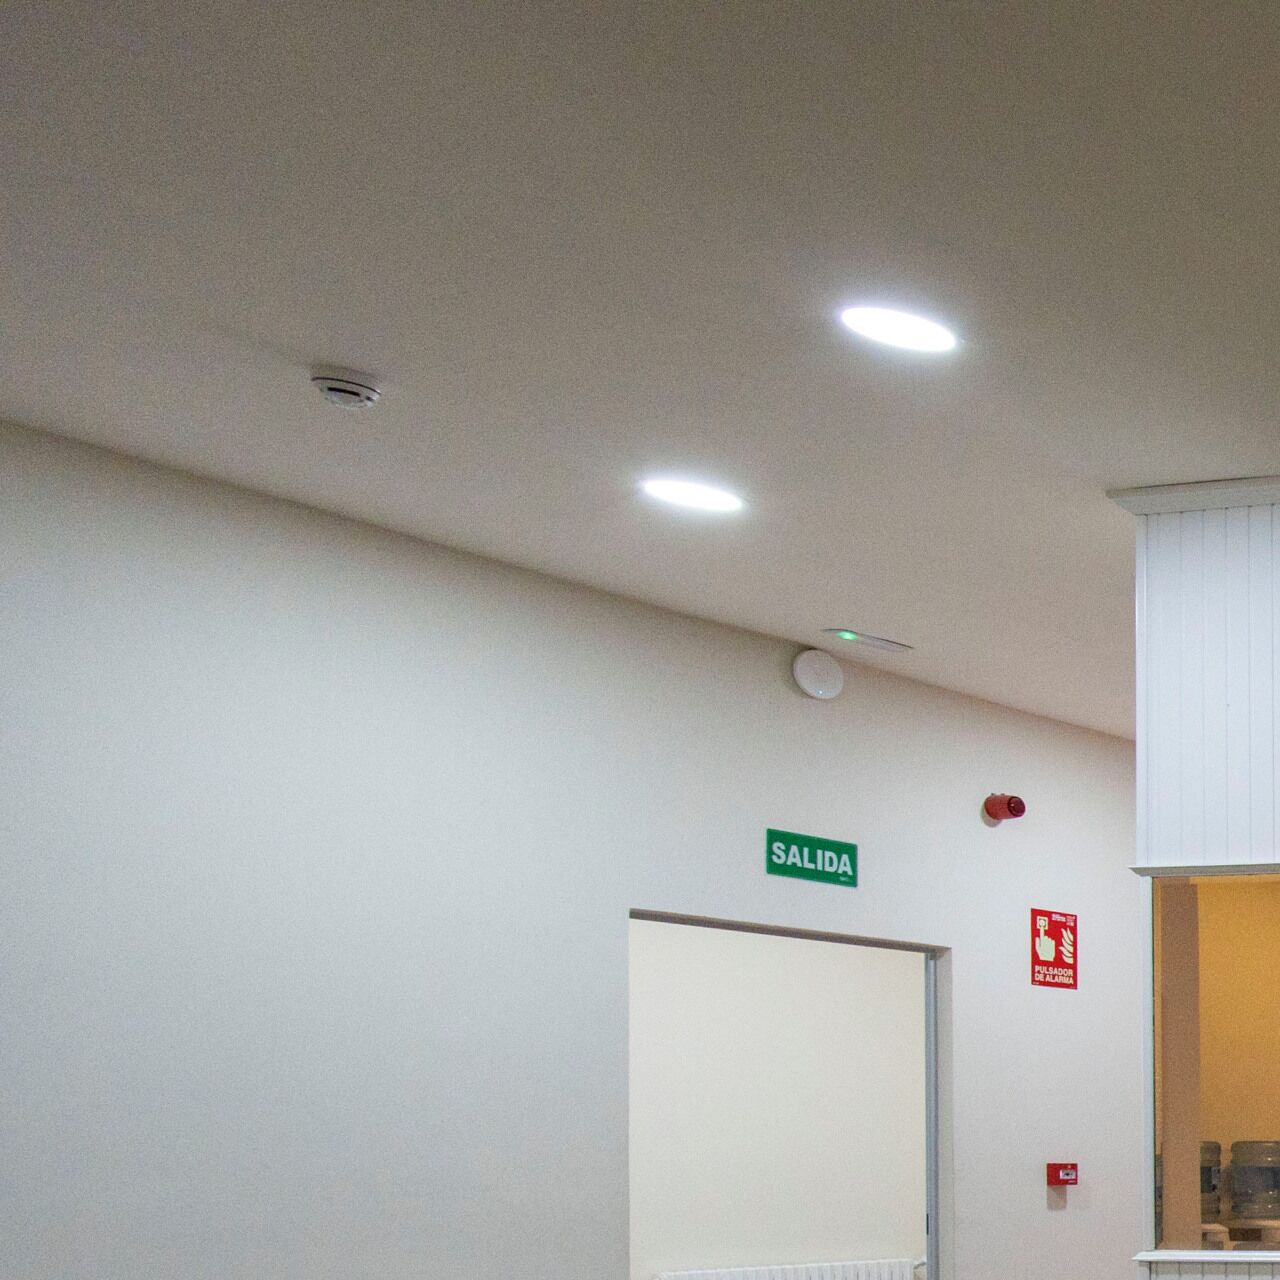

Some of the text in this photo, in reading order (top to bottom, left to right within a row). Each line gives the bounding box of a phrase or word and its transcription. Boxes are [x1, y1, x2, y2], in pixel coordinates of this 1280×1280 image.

[771, 841, 853, 876] SALIDA
[1034, 965, 1074, 977] PULSADOR
[1034, 973, 1045, 981] DE
[1045, 974, 1074, 984] ALARMA
